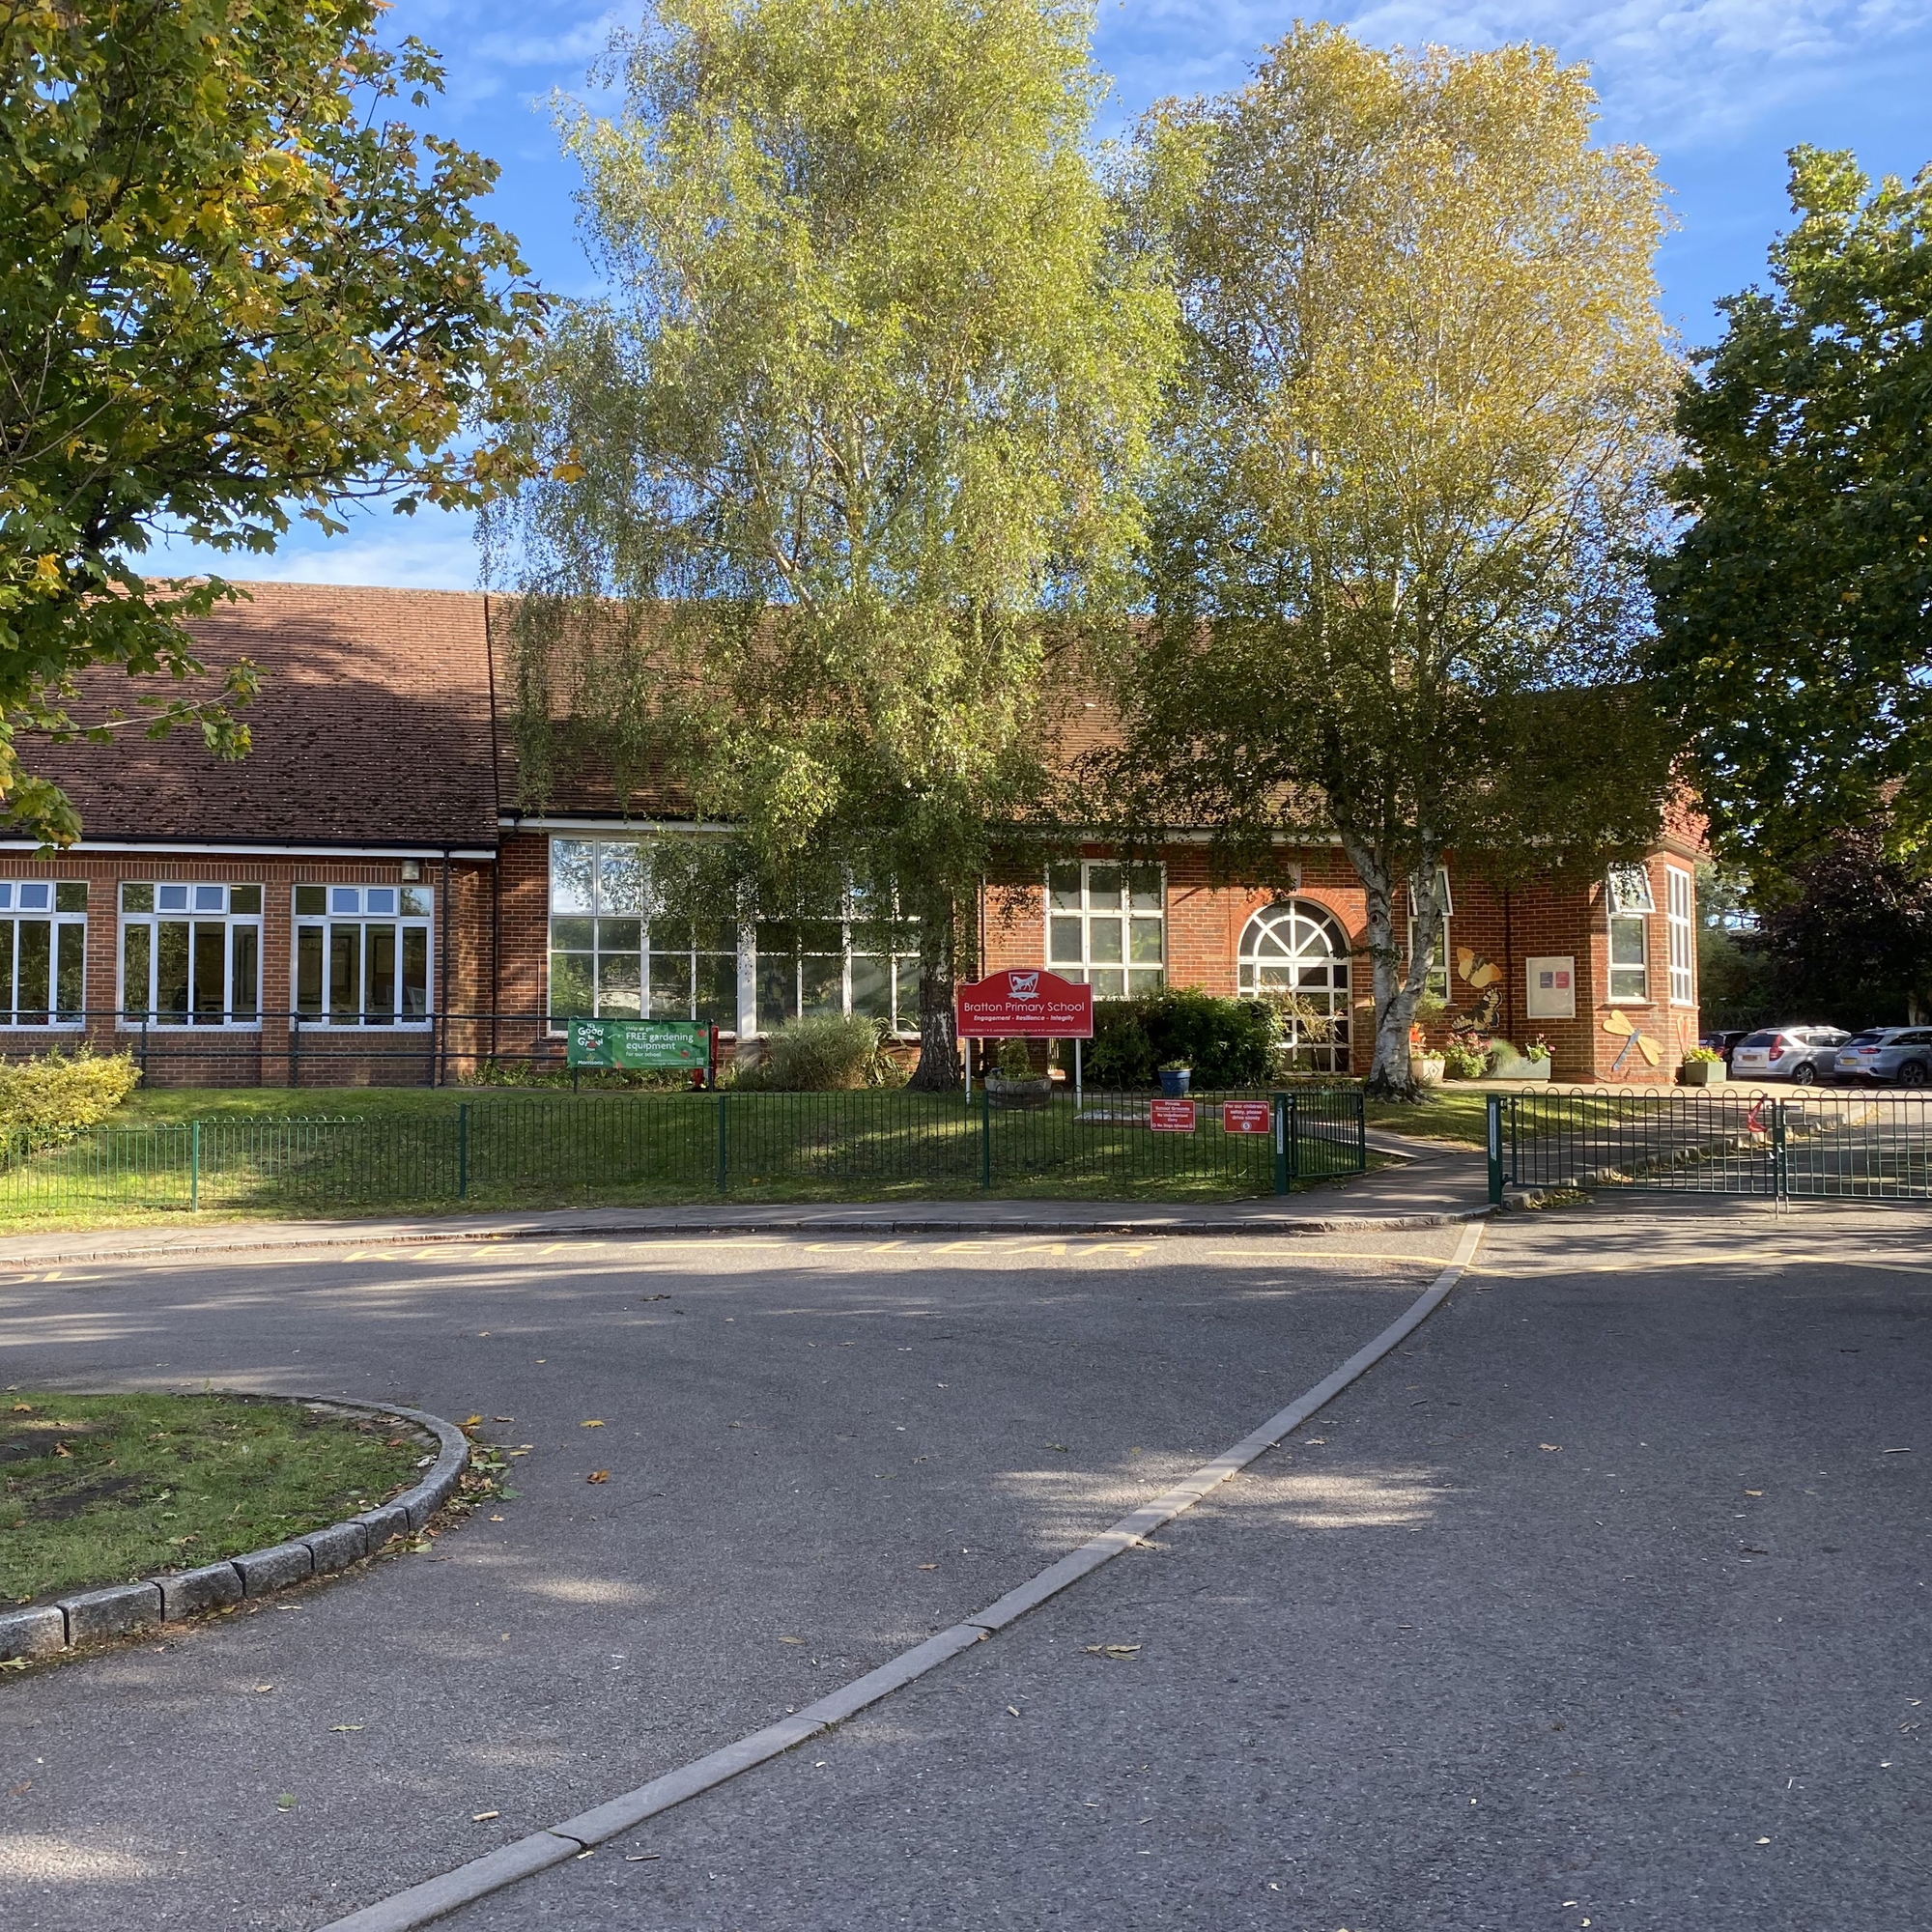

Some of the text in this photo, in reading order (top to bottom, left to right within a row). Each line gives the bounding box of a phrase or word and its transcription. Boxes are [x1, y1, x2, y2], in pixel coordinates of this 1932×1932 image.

[964, 1002, 1085, 1013] Bratton Primary School
[578, 1027, 604, 1037] Good
[626, 1032, 694, 1043] FREE gardening
[626, 1041, 676, 1051] equipment
[341, 1242, 607, 1264] KEEP
[803, 1240, 1159, 1257] CLEAR
